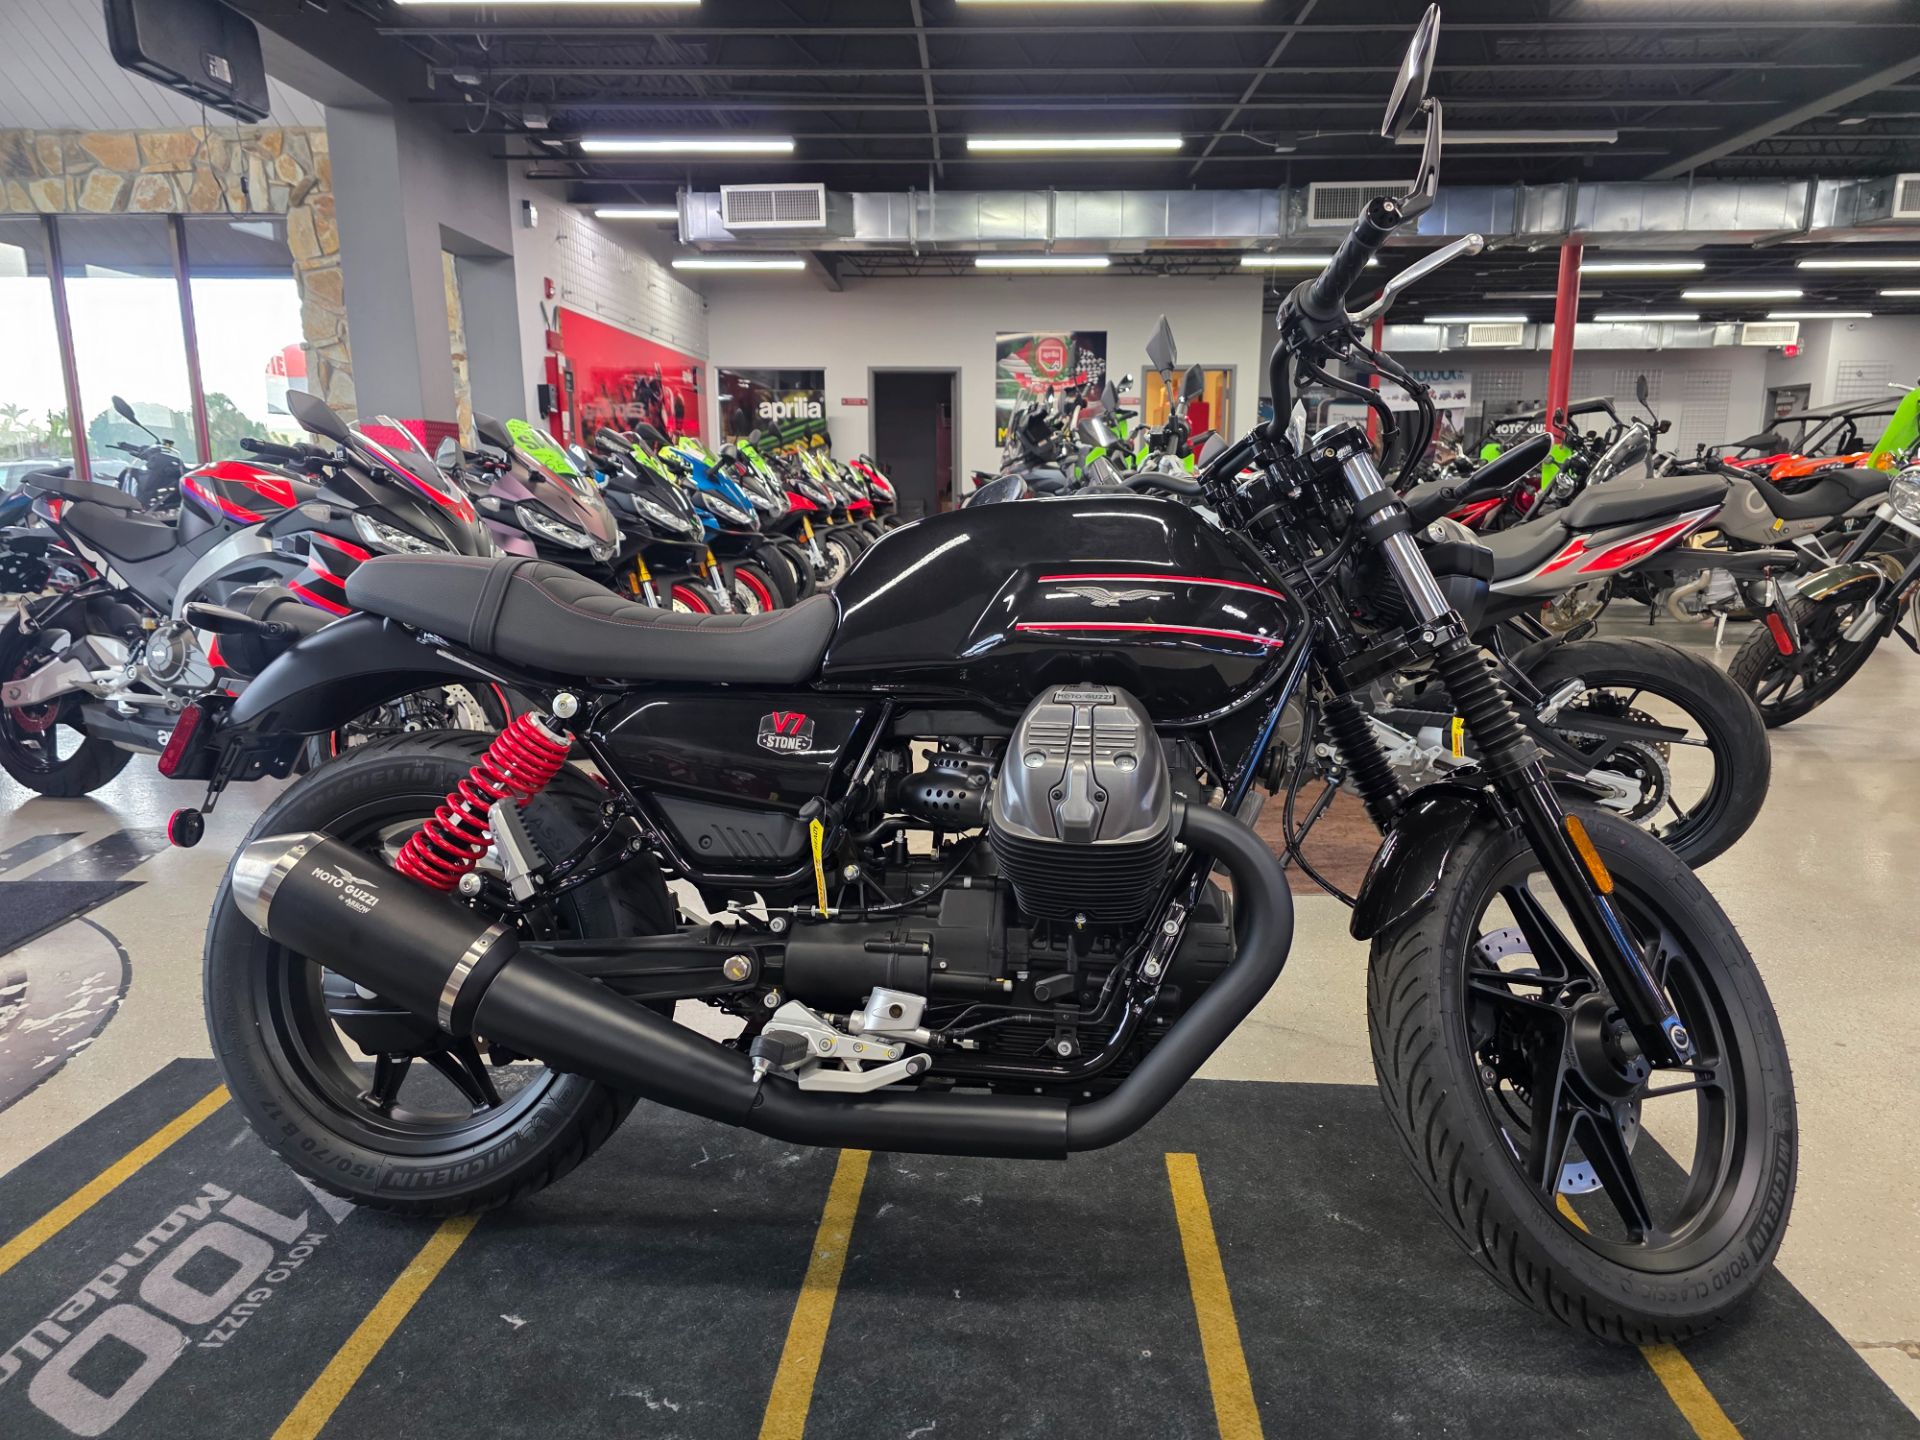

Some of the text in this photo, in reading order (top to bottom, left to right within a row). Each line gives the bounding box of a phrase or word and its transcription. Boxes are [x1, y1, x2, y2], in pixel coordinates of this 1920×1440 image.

[758, 396, 822, 423] aprilia
[766, 735, 803, 751] STONE
[772, 711, 806, 736] V7
[311, 867, 379, 907] MOTO GUZZI
[301, 1135, 377, 1181] 150/70
[388, 1135, 519, 1189] MICHELIN
[1750, 1137, 1791, 1255] MICHELIN
[198, 1233, 327, 1349] MOTO GUZZI
[1711, 1252, 1750, 1291] ROAD
